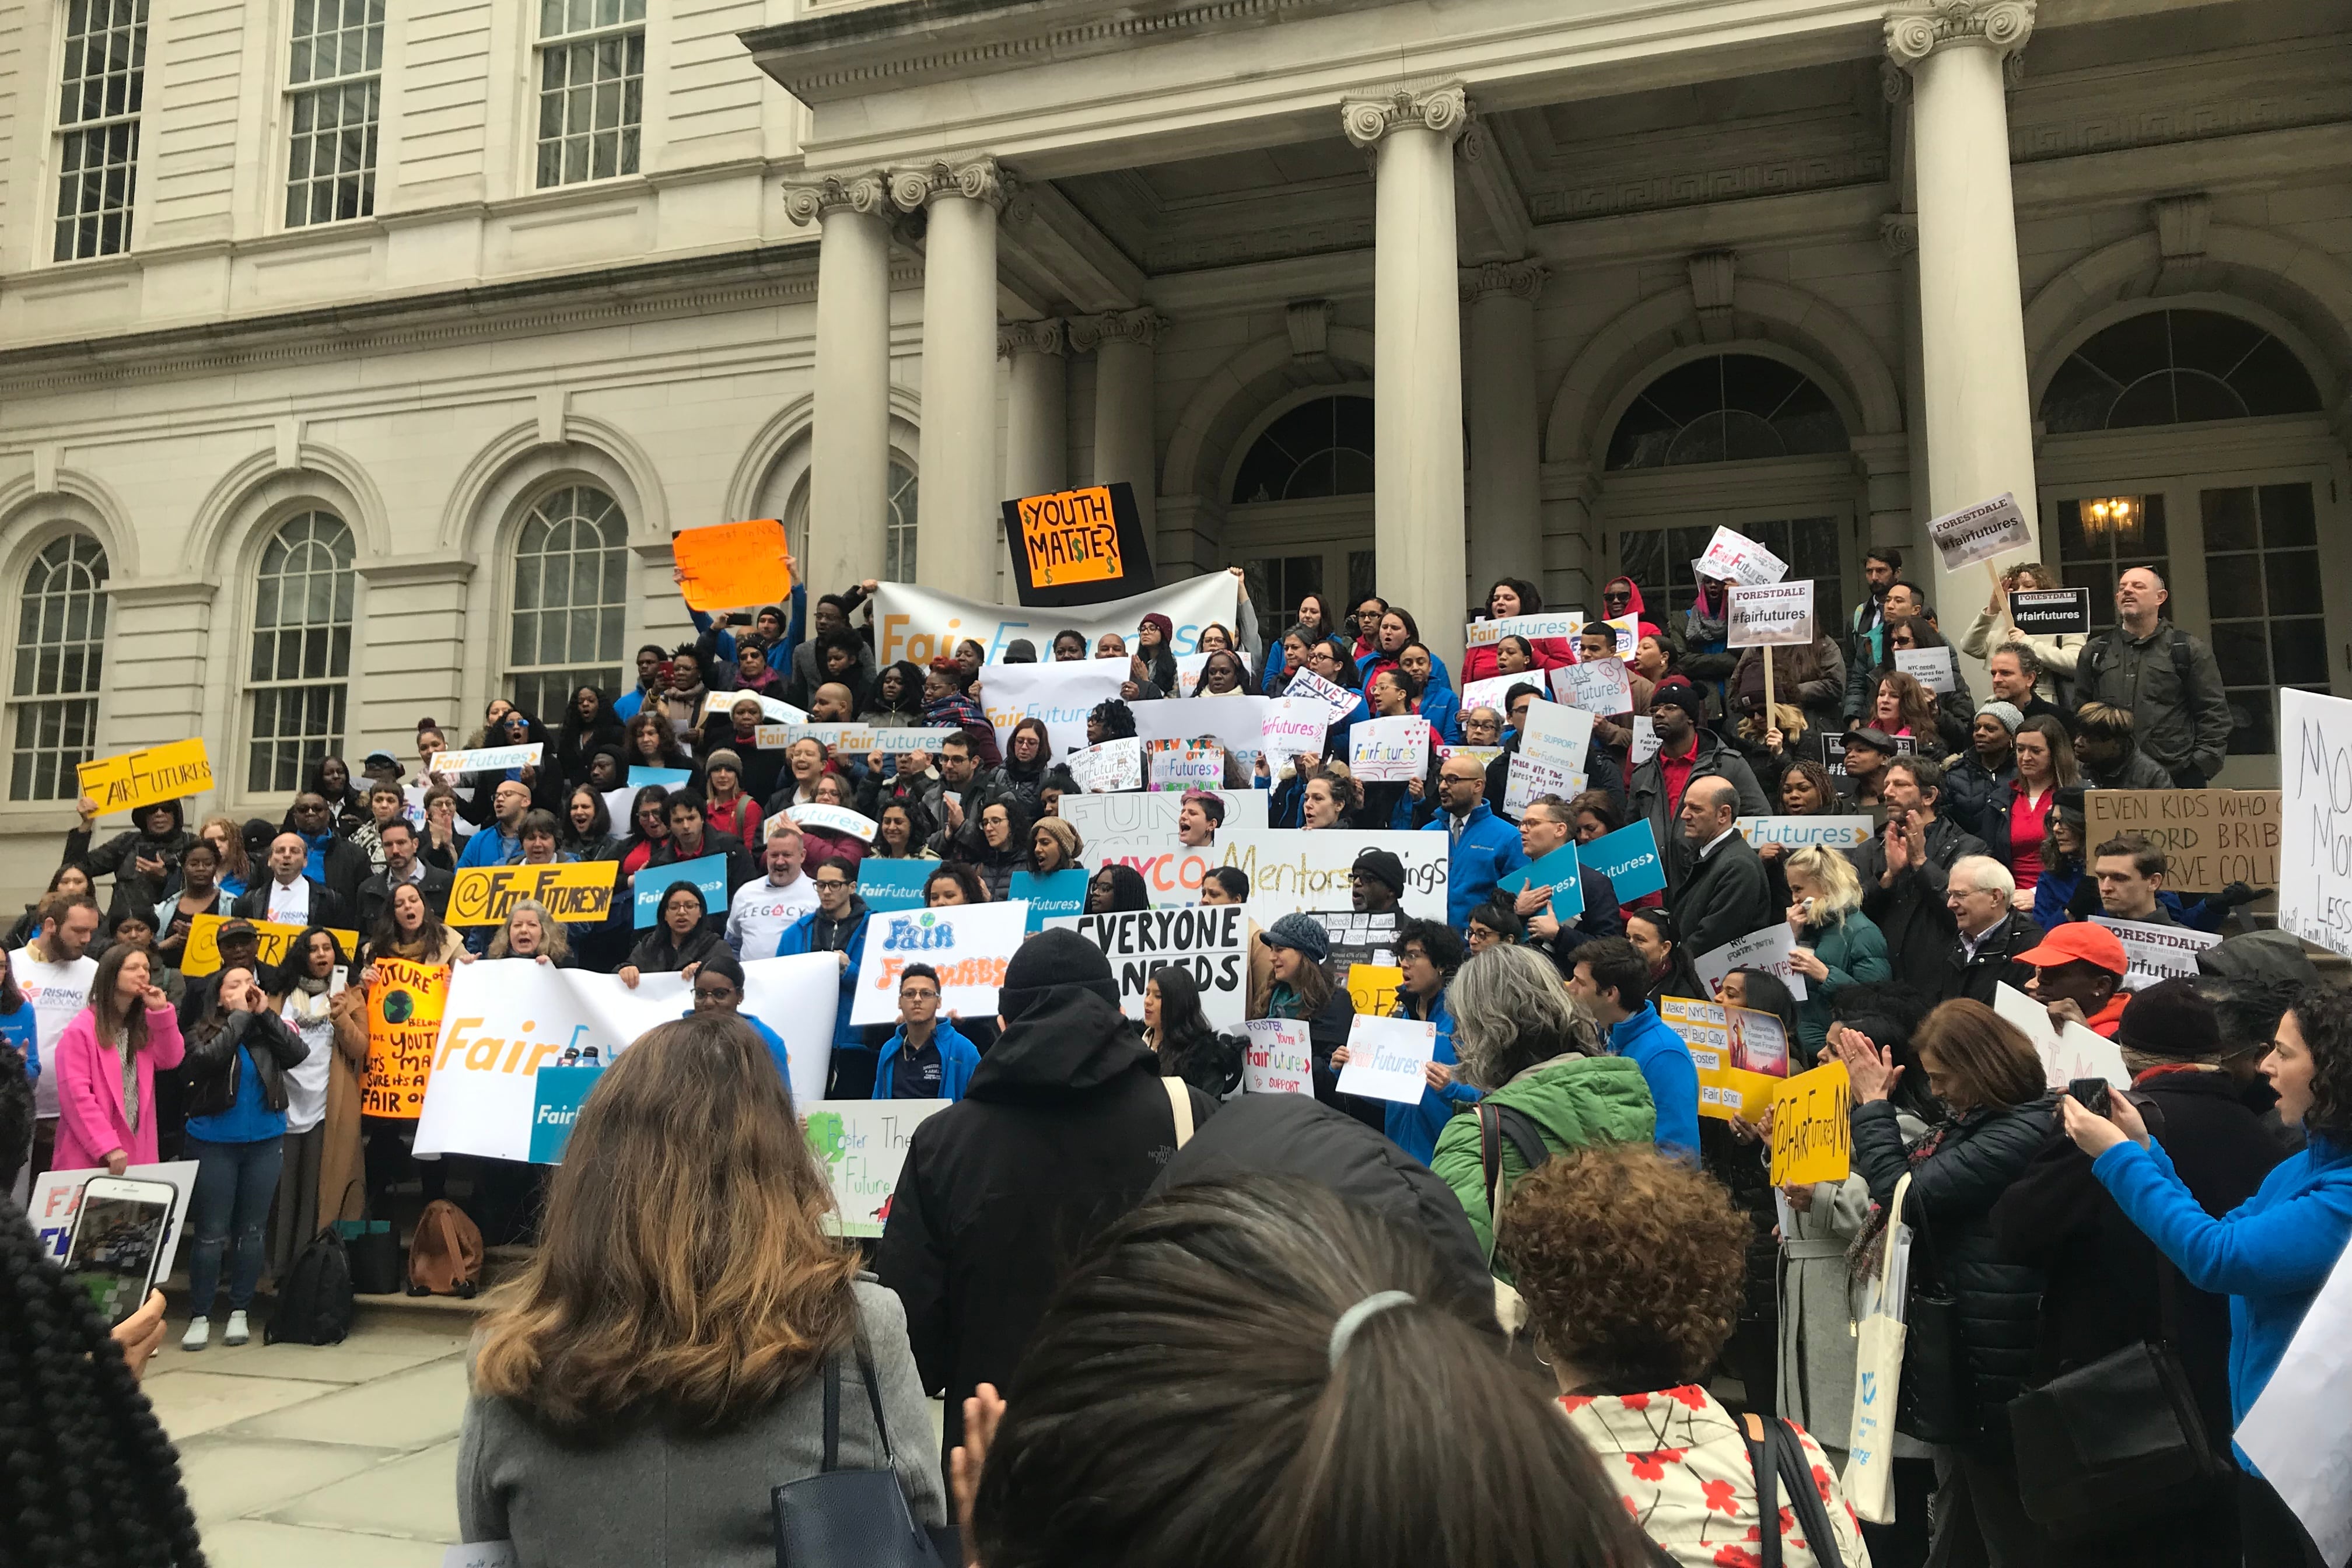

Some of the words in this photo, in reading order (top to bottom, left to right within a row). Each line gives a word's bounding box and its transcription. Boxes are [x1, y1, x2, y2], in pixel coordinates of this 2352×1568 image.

[1026, 495, 1107, 530] YOUTH
[1936, 499, 2008, 532] FORESTDALE
[1943, 517, 2018, 551] #fairfutures
[1028, 524, 1118, 570] MATTER
[1736, 587, 1805, 600] FORESTDALE
[2020, 592, 2077, 601] FORESTDALE
[1732, 610, 1805, 624] #fairfutures
[2017, 611, 2080, 621] #fairfutures
[1470, 620, 1566, 642] FairFutures
[1564, 663, 1594, 678] NYC
[1303, 671, 1357, 708] INVEST
[1558, 683, 1620, 704] FairFutures
[1115, 740, 1132, 751] NYC
[1154, 738, 1181, 752] NEW
[1186, 738, 1213, 750] YORK
[1531, 730, 1543, 740] WE
[1544, 734, 1578, 750] SUPPORT
[433, 751, 529, 771] FairFutures
[1354, 742, 1416, 761] FairFutures
[1527, 747, 1569, 766] FairFutures
[1153, 758, 1212, 776] FairFutures
[2095, 794, 2148, 821] EVEN
[2162, 794, 2210, 819] KIDS
[2220, 796, 2266, 817] WHO
[1224, 841, 1352, 898] Mentors
[2317, 874, 2352, 934] LESS
[1329, 917, 1350, 926] Needs
[1354, 916, 1367, 925] Fair
[1371, 916, 1394, 925] Futures
[1345, 933, 1365, 941] Foster
[1367, 933, 1388, 942] Youth
[1729, 937, 1746, 948] NYC
[432, 968, 443, 981] of
[42, 988, 83, 999] RISING
[1664, 1002, 1685, 1014] Make
[1688, 1007, 1706, 1018] NYC
[1708, 1009, 1724, 1021] The
[1245, 1021, 1283, 1031] FOSTER
[1275, 1032, 1295, 1045] YOUTH
[1692, 1031, 1706, 1043] Big
[1246, 1043, 1305, 1072] FairFutures
[1348, 1041, 1419, 1074] FairFutures
[367, 1072, 390, 1087] SURE
[413, 1074, 424, 1086] A
[1269, 1077, 1300, 1093] SUPPORT
[362, 1088, 401, 1112] FAIR
[1703, 1088, 1718, 1100] Fair
[827, 1119, 868, 1149] Foster
[881, 1116, 912, 1149] The
[845, 1157, 890, 1195] Future
